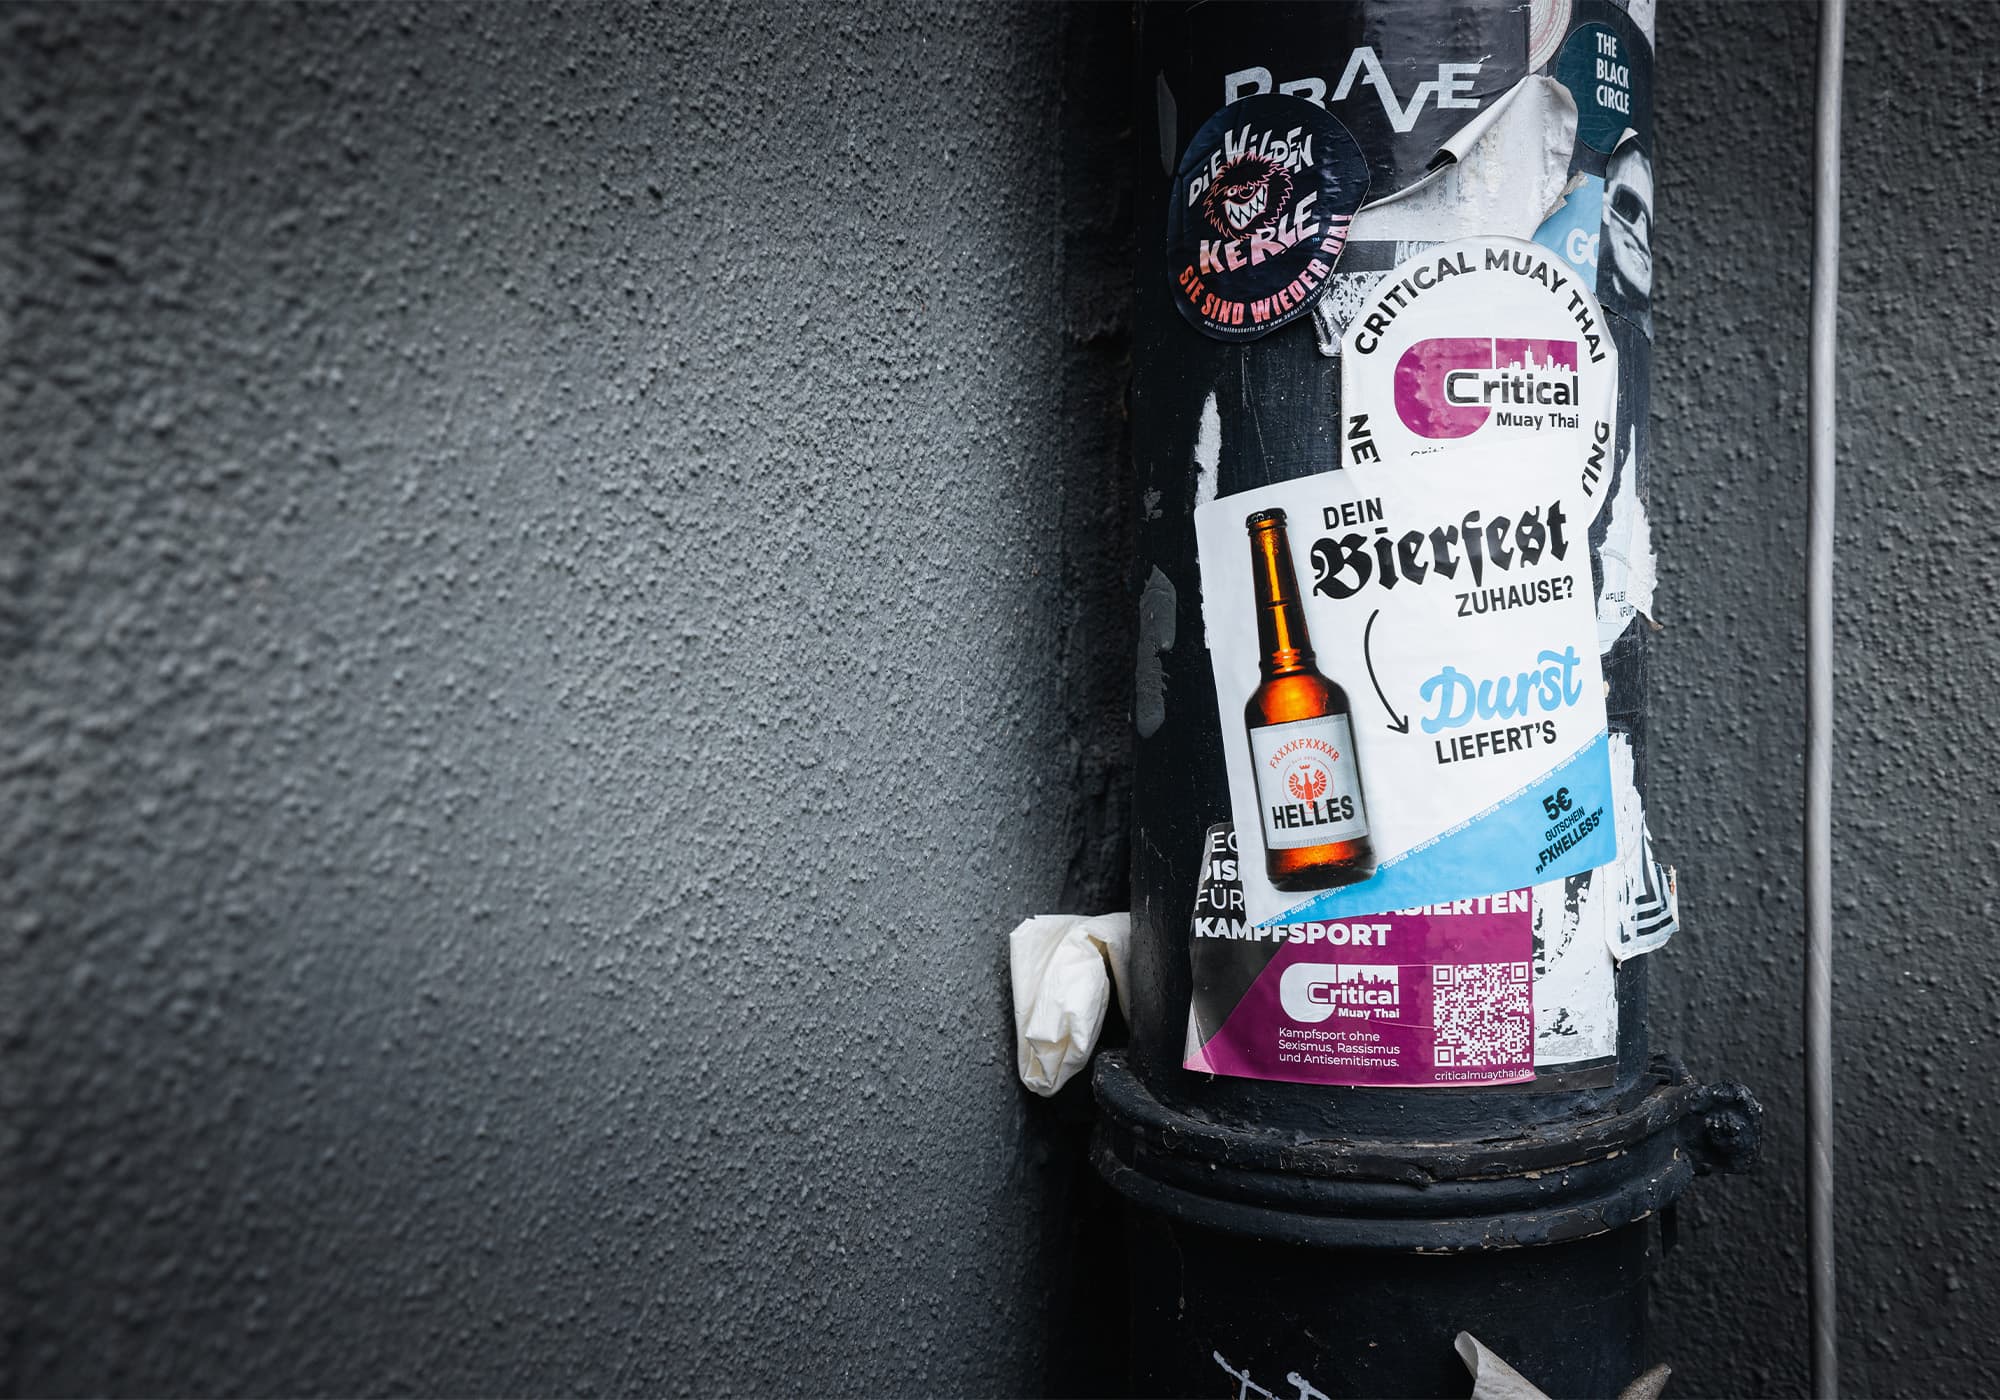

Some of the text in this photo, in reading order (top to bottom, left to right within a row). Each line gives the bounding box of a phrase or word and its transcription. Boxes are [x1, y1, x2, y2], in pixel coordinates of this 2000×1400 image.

[1596, 32, 1617, 58] THE
[1596, 58, 1630, 89] BLACK
[1596, 85, 1630, 114] CIRCLE
[1200, 191, 1320, 275] KERLE
[1179, 265, 1202, 304] SIE
[1201, 293, 1244, 325] SIND
[1250, 257, 1330, 324] WIEDER
[1320, 214, 1353, 255] DA!
[1354, 251, 1477, 355] CRITICAL
[1485, 247, 1567, 294] MUAY
[1566, 290, 1606, 364] THAI
[1446, 371, 1580, 407] Critical
[1496, 412, 1580, 430] Muay Thai
[1323, 496, 1383, 530] DEIN
[1310, 500, 1568, 600] Bierfest
[1455, 575, 1574, 618] ZUHAUSE?
[1420, 646, 1582, 734] Durst
[1271, 795, 1355, 829] HELLES
[1542, 787, 1572, 820] 5€
[1545, 806, 1585, 841] GUTSCHEIN
[1290, 898, 1316, 914] COUPON
[1382, 853, 1409, 870] COUPON
[1413, 836, 1440, 853] COUPON
[1195, 884, 1245, 911] FÜR
[1194, 917, 1392, 946] KAMPFSPORT
[1307, 983, 1400, 1005] Critical
[1338, 1008, 1400, 1020] Muay Thai
[1278, 1040, 1400, 1055] Sexismus, Rassismus
[1279, 1027, 1380, 1041] Kampfsport ohne
[1279, 1053, 1400, 1067] und Antisemitismus.
[1434, 1066, 1530, 1081] criticalmuaythai.de
